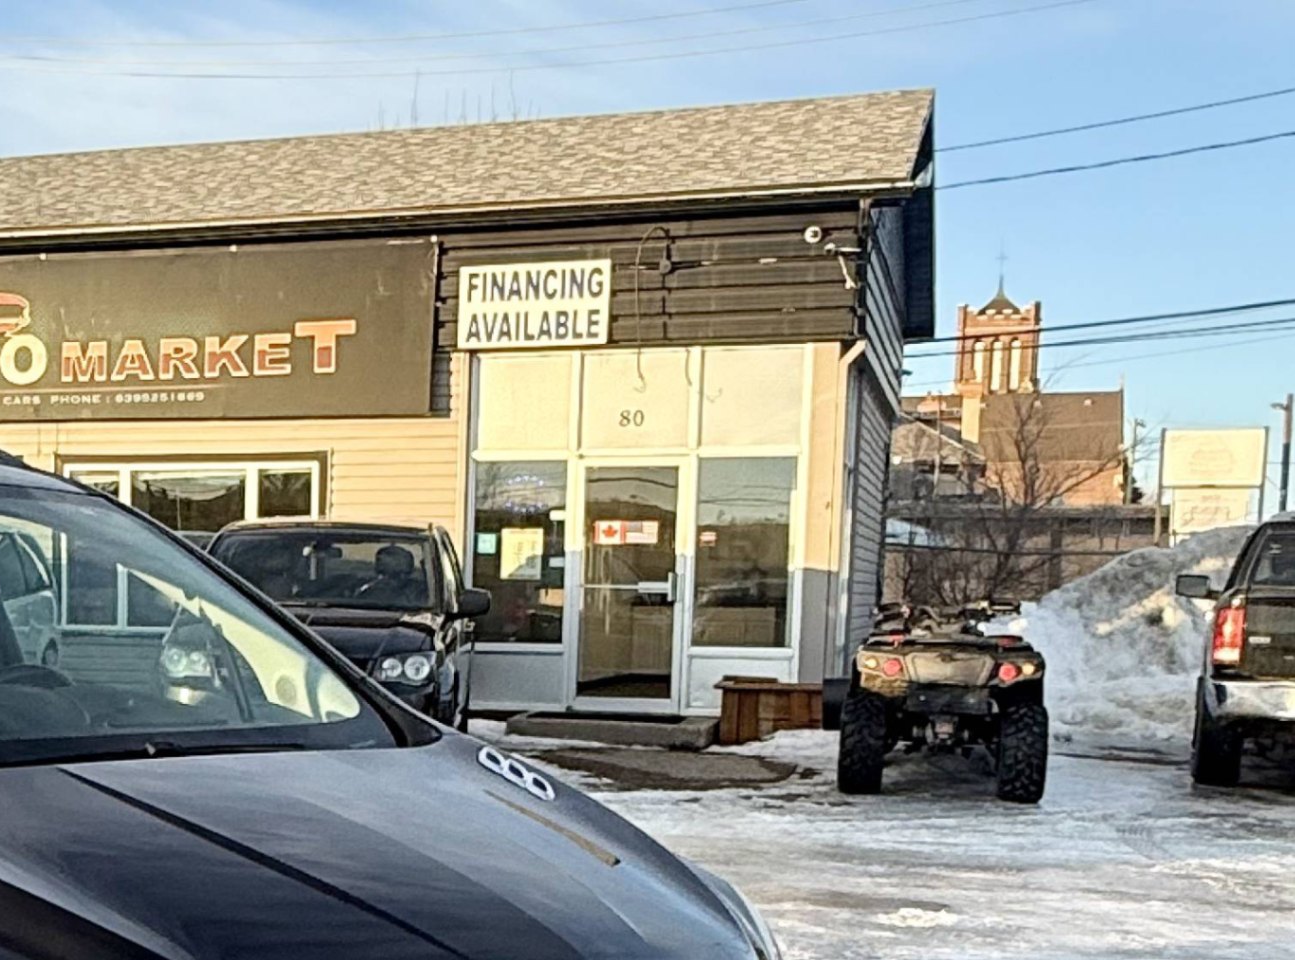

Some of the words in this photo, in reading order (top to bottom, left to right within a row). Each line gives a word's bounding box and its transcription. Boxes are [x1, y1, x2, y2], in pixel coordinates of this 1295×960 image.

[467, 267, 604, 303] FINANCING
[466, 309, 600, 342] AVAILABLE
[61, 319, 356, 382] MARKET
[3, 395, 41, 406] CARS
[50, 393, 102, 405] PHONE
[618, 409, 645, 428] 80
